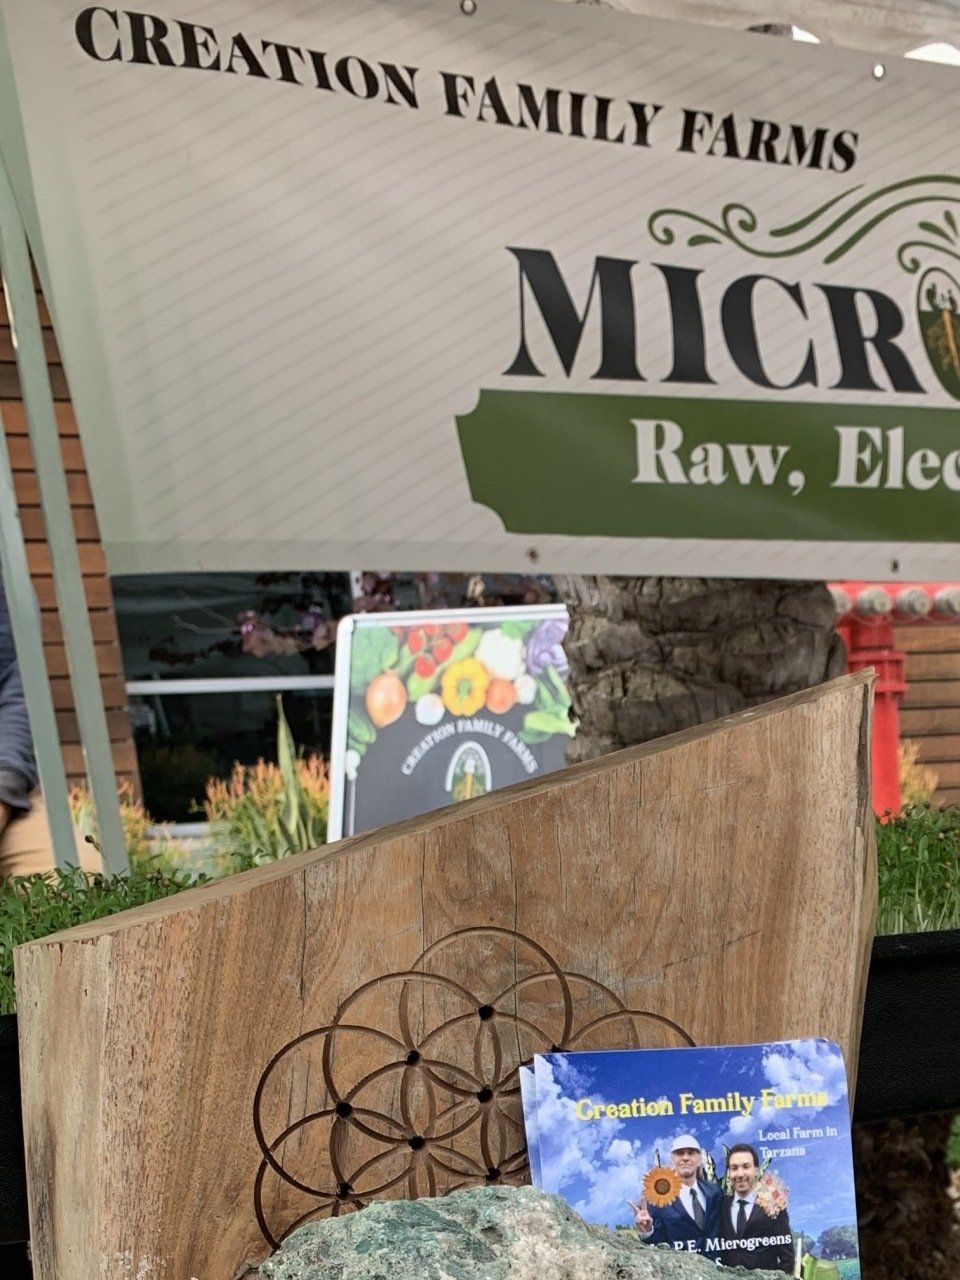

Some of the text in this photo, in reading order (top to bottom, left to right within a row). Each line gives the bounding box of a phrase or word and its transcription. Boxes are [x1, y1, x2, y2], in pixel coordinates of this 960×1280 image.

[74, 6, 860, 174] CREATION FAMILY FARMS
[630, 418, 805, 496] Raw,
[401, 718, 539, 775] CREATION FAMILY FARMS
[575, 1088, 828, 1122] Creation Family Farms
[758, 1126, 838, 1142] Local Farm in
[759, 1146, 806, 1158] Tarzana
[705, 1234, 792, 1252] Microgreens
